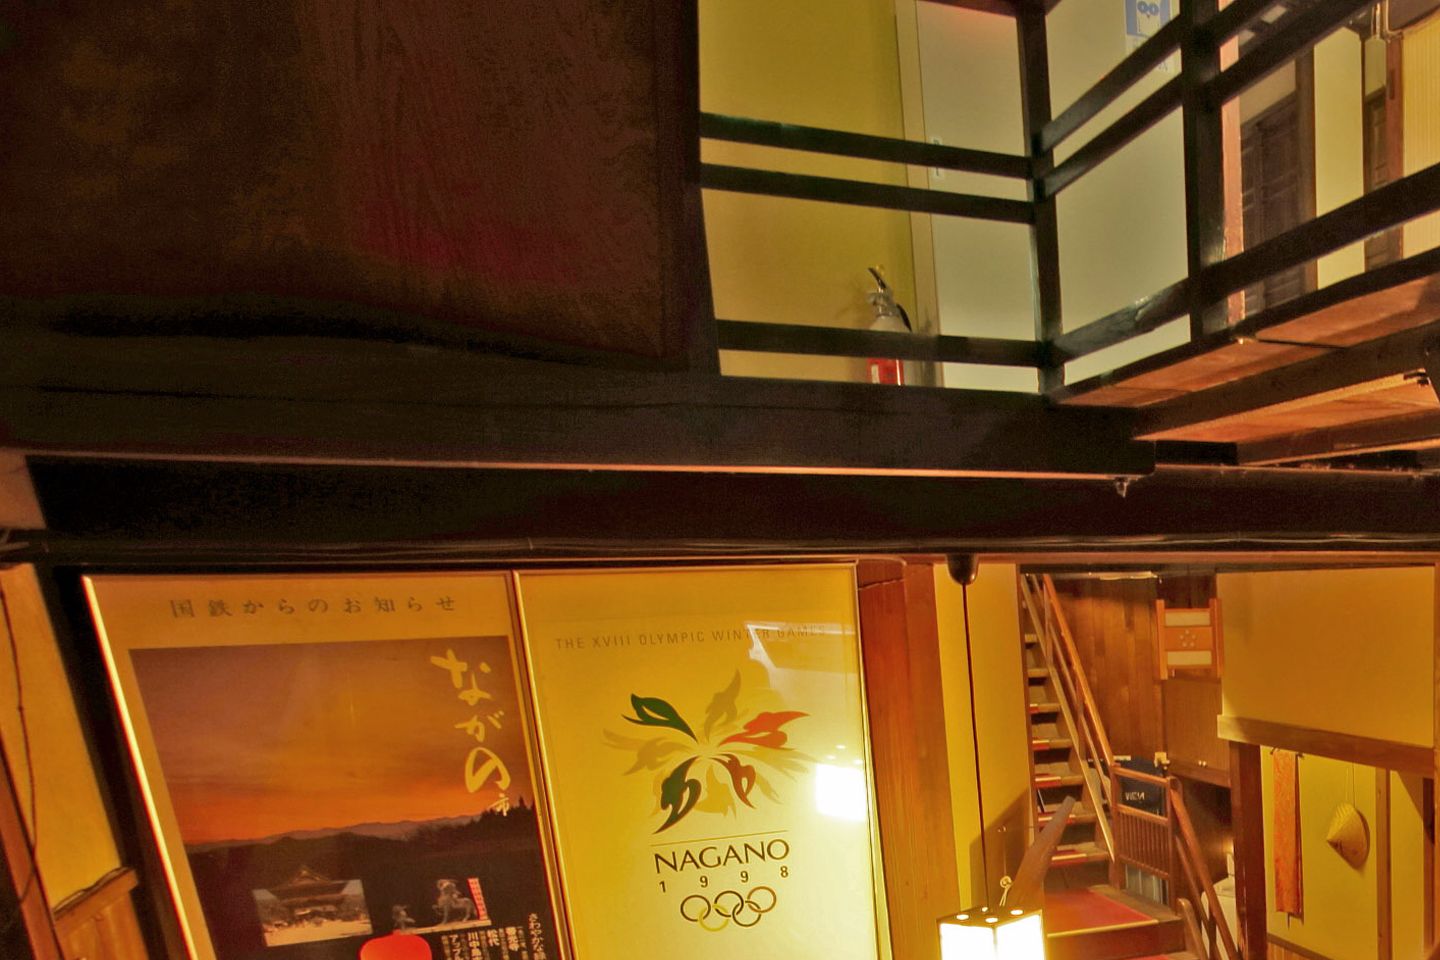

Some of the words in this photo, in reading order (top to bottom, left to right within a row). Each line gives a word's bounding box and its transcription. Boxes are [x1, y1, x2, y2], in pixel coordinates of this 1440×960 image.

[169, 596, 456, 618] 国鉄からのお知らせ
[555, 637, 585, 651] THE
[592, 635, 632, 649] XVIII
[639, 632, 706, 647] OLYMPIC
[711, 629, 770, 642] WINTER
[654, 838, 790, 874] NAGANO
[658, 864, 789, 893] 1998
